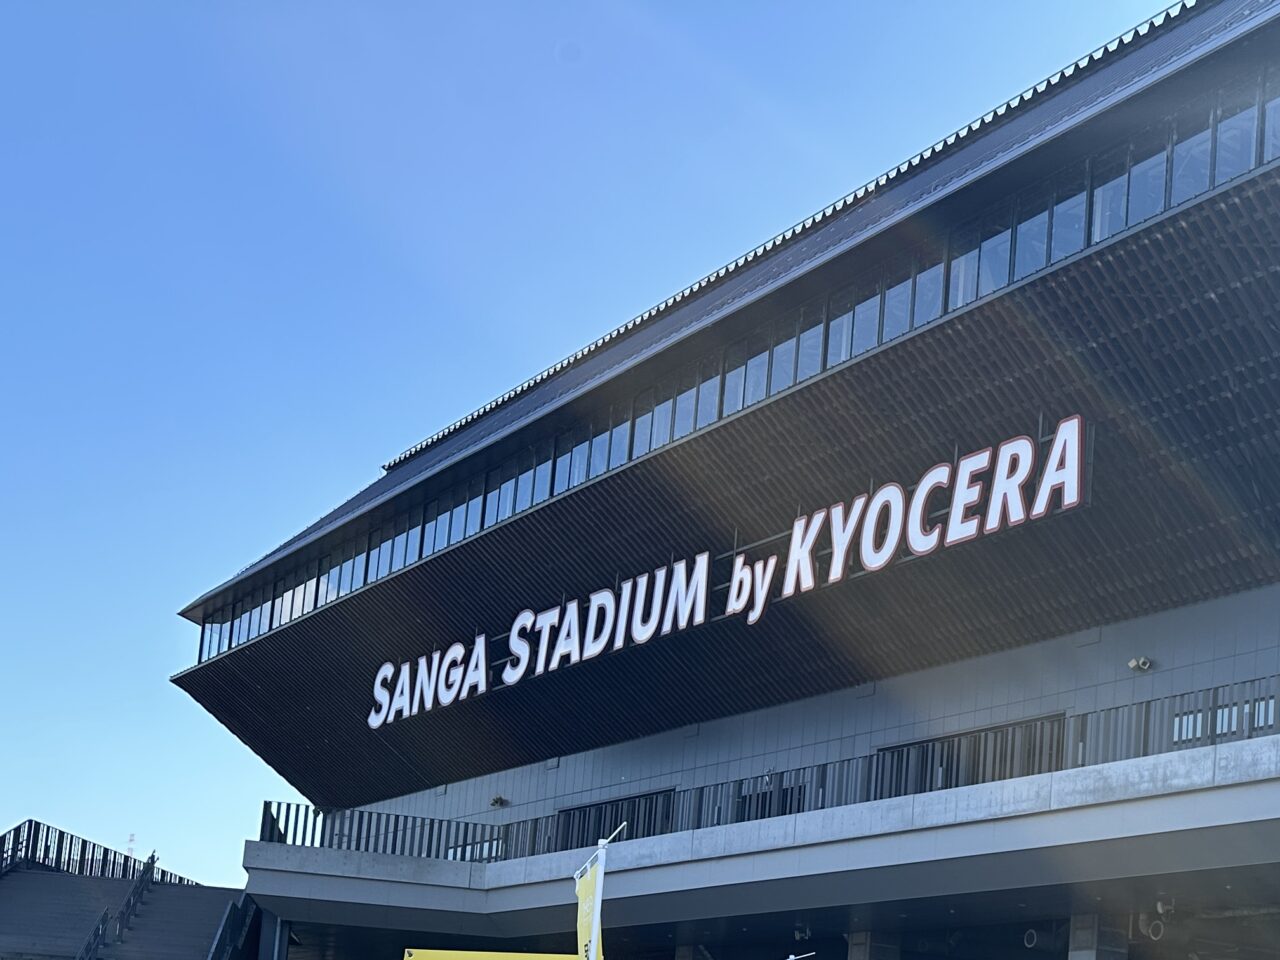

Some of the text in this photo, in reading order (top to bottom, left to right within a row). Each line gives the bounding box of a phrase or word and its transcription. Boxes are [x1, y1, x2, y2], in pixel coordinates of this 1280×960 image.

[366, 414, 1082, 730] SANGA STADIUM by KYOCERA
